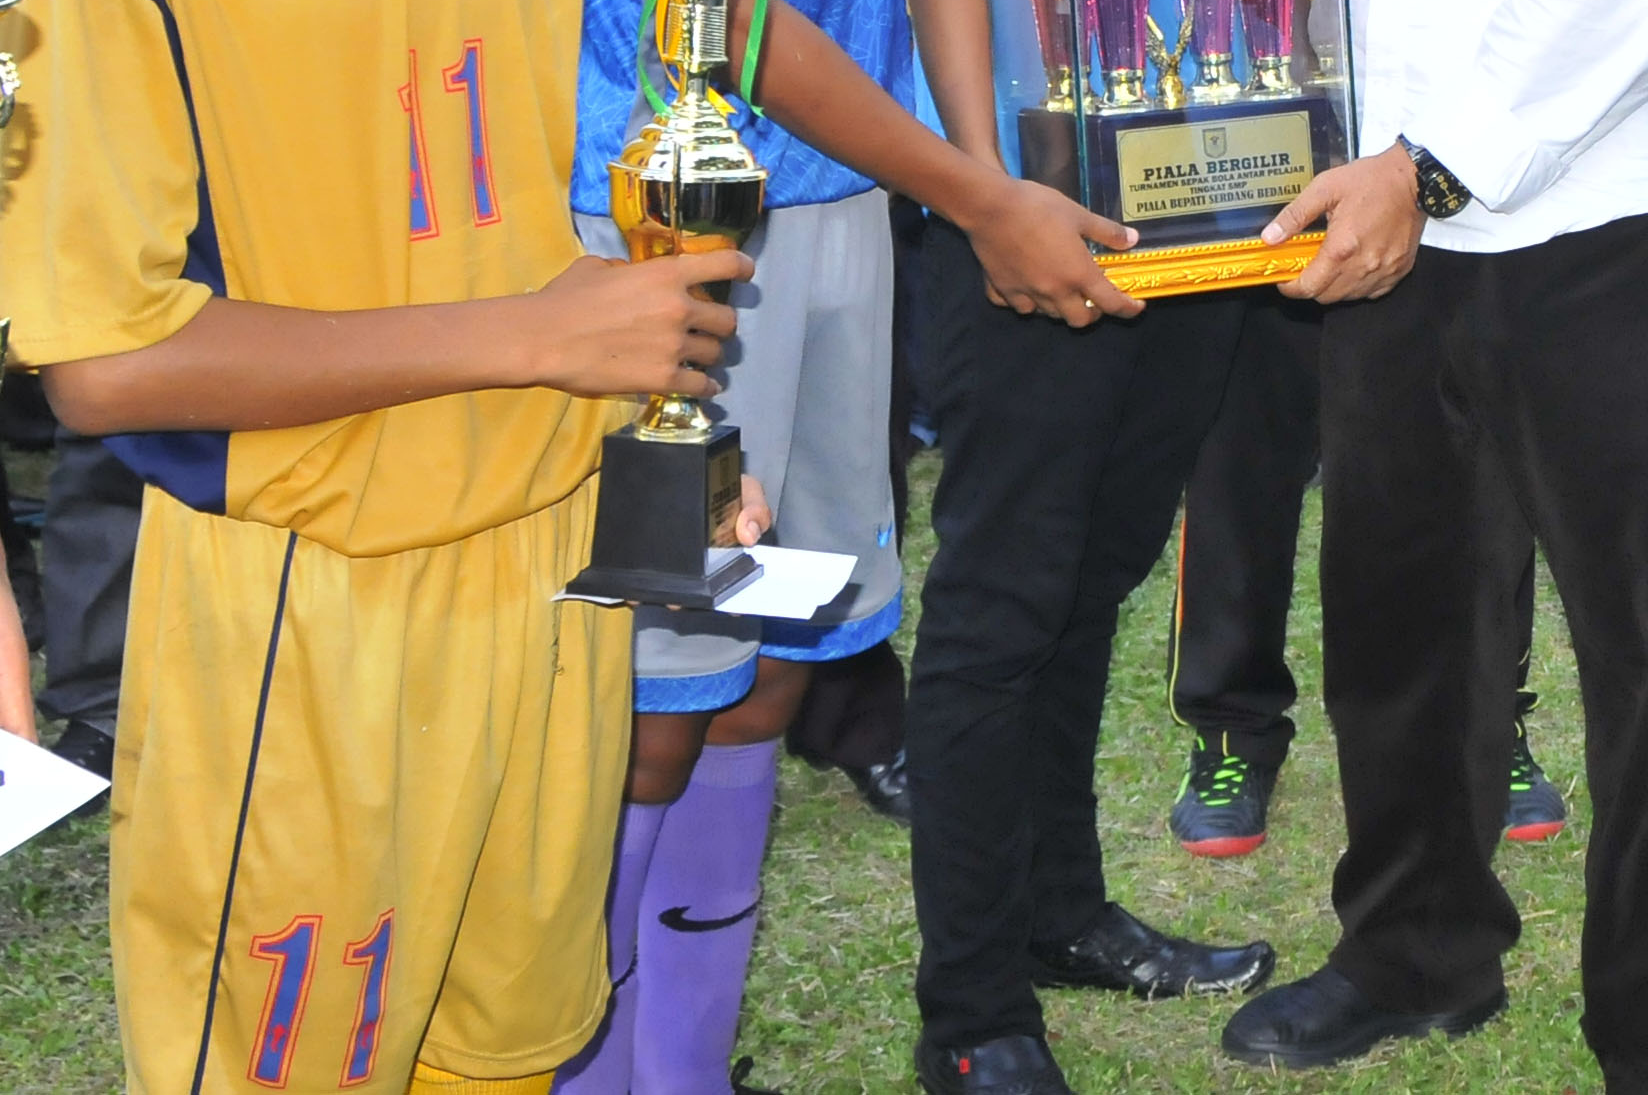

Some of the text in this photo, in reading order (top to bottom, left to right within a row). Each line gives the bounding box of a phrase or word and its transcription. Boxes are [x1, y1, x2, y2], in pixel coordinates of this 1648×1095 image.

[398, 38, 502, 242] 11
[1128, 165, 1305, 193] TURNAMEN SEPAK BOLA ANTAR PELAJAR
[1143, 152, 1290, 182] PIALA BERGILIR
[1136, 183, 1302, 213] PIALA BUPATI SERDANG BEDAGAI
[1189, 180, 1248, 195] TINGKAT SMP
[247, 908, 394, 1090] 11
